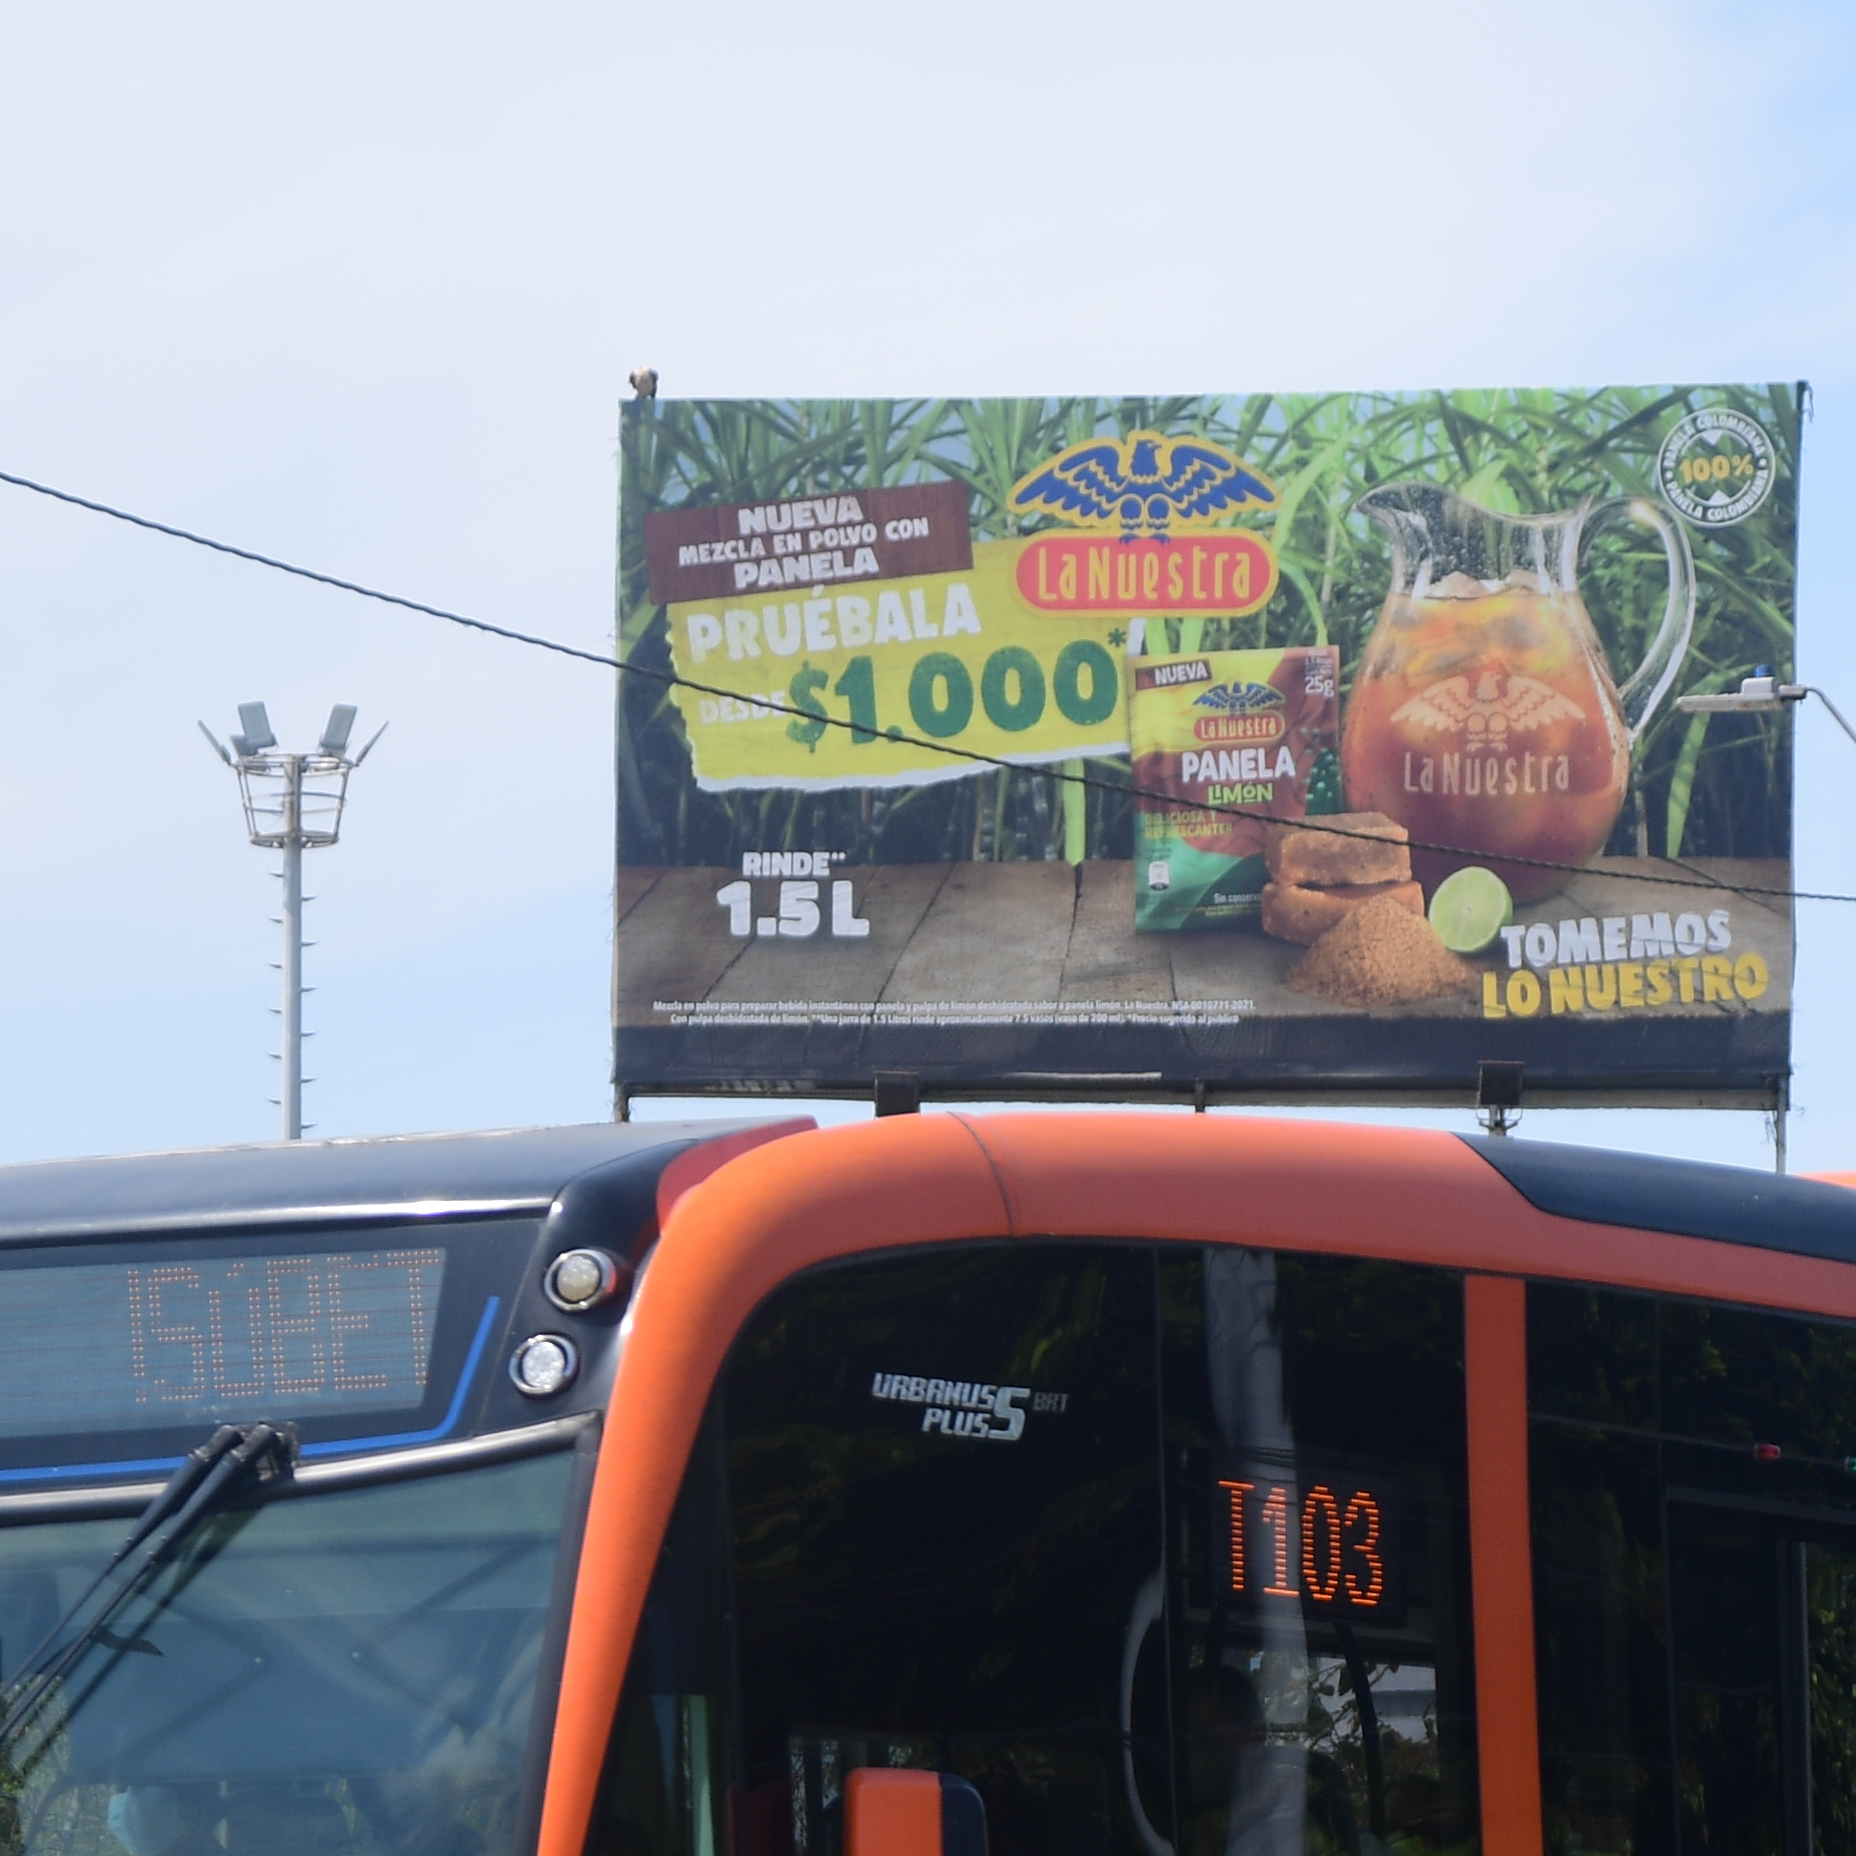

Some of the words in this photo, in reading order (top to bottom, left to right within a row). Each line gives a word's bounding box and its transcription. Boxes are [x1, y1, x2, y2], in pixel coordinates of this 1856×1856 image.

[1680, 453, 1754, 484] 100%
[738, 496, 864, 535] NUEVA
[678, 537, 766, 567] MEZCLA
[773, 532, 802, 554] EN
[808, 522, 878, 551] POLVO
[885, 517, 930, 541] CON
[734, 547, 879, 589] PANELA
[686, 583, 982, 664] PRUÉBALA
[1154, 661, 1208, 685] NUEVA
[1305, 675, 1335, 698] 25g
[699, 690, 786, 726] DESDE
[1181, 746, 1296, 783] PANELA
[1207, 782, 1273, 805] LIMÓN
[716, 880, 821, 936] 1.5
[832, 880, 870, 936] L
[1228, 891, 1262, 903] conserv
[1500, 909, 1732, 969] TOMEMOS
[1483, 969, 1541, 1019] LO
[1548, 952, 1769, 1014] NUESTRO
[671, 1014, 686, 1023] Con
[696, 1000, 719, 1012] polvo
[721, 1003, 740, 1012] para
[1034, 1000, 1057, 1010] sabor
[1218, 1479, 1383, 1605] T103
